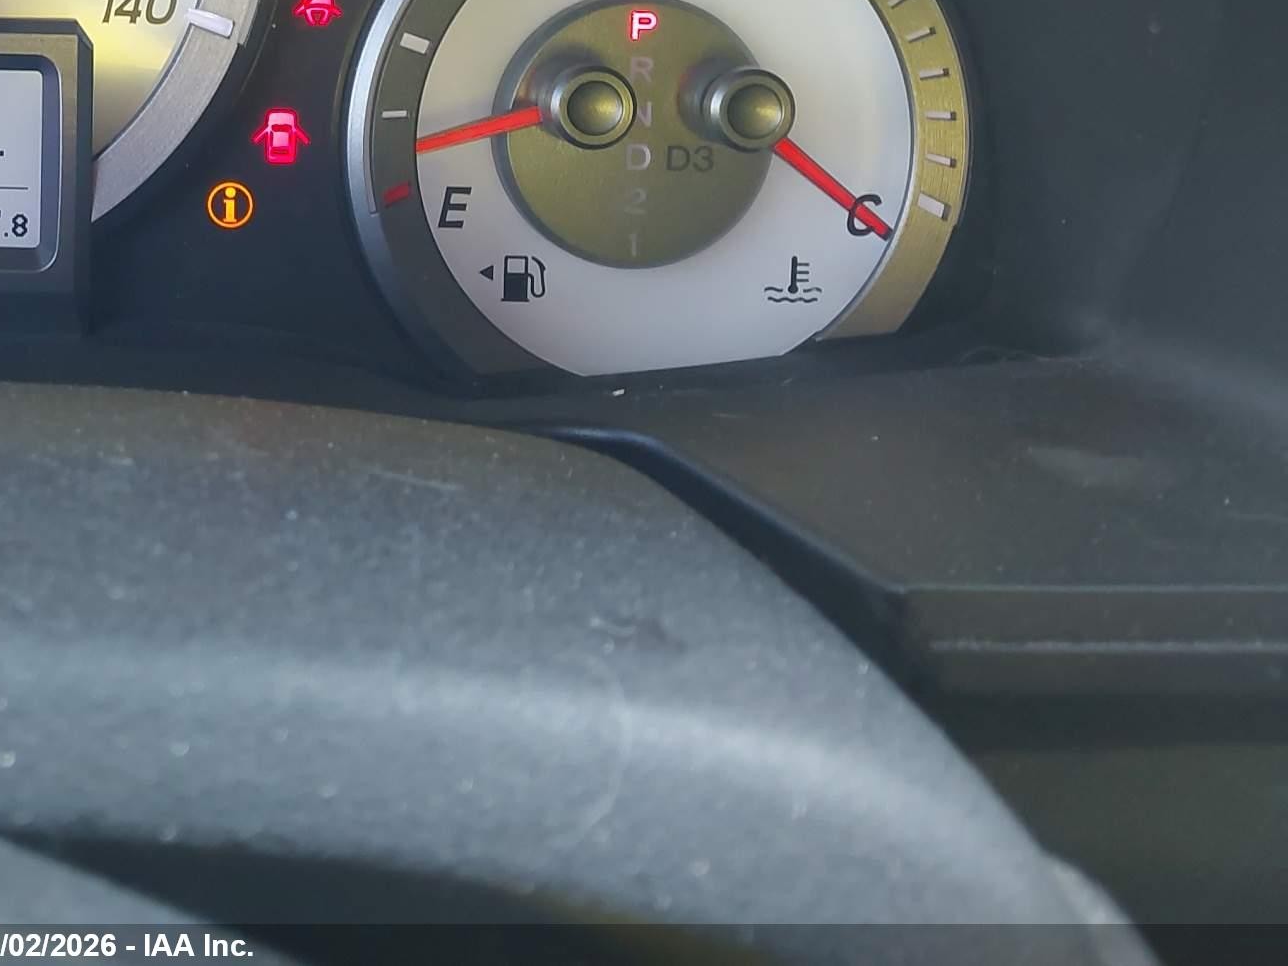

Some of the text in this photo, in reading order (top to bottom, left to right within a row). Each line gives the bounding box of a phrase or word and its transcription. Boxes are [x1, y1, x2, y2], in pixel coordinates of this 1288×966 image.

[630, 11, 657, 41] P
[630, 57, 654, 82] R
[627, 144, 652, 170] D
[667, 145, 714, 171] D3
[438, 186, 472, 228] E
[847, 194, 881, 236] C
